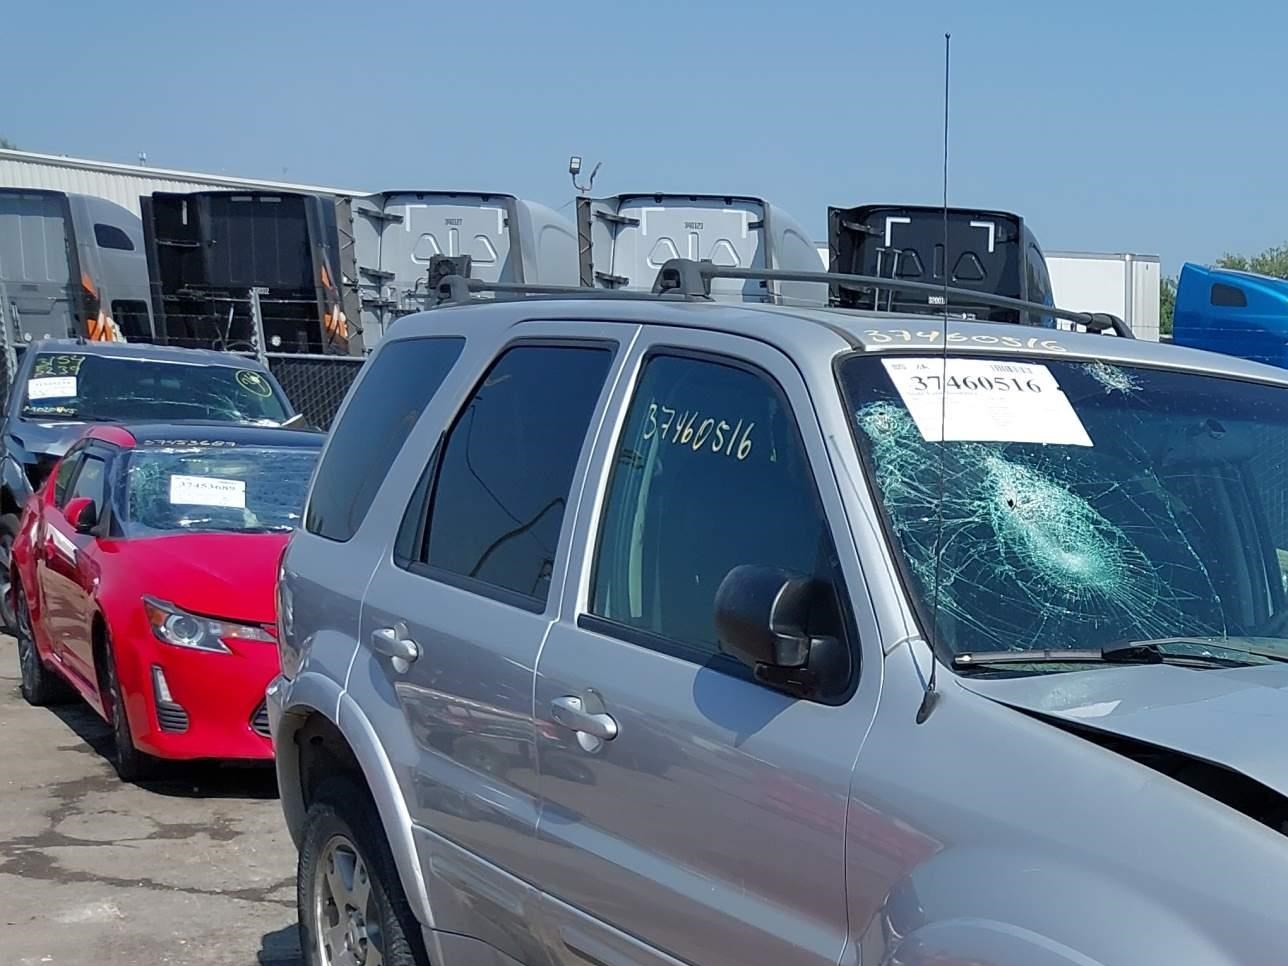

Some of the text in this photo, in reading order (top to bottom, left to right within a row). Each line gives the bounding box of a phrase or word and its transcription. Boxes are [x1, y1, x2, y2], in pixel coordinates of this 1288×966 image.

[863, 329, 1067, 352] 37460516
[910, 375, 1043, 394] 37460516
[643, 403, 755, 460] 37460516
